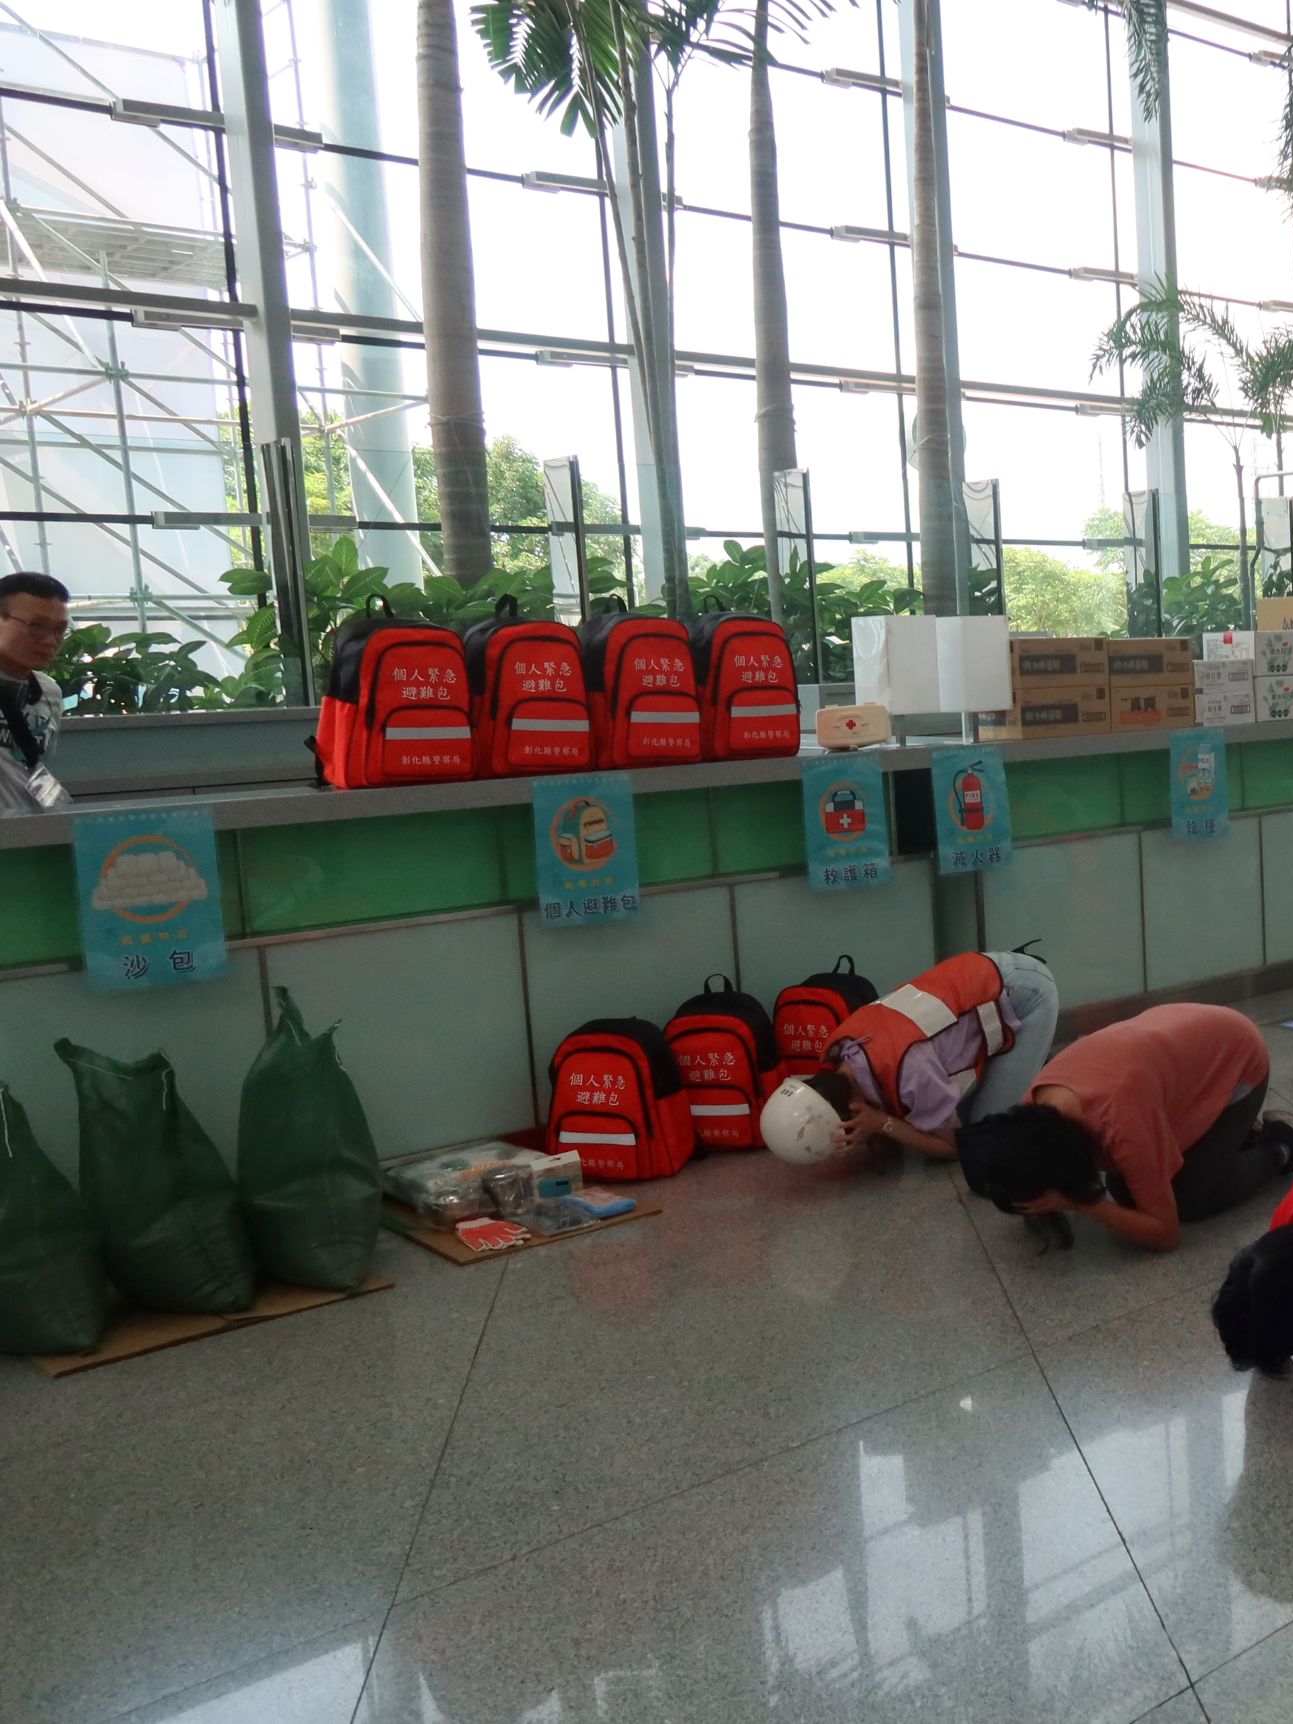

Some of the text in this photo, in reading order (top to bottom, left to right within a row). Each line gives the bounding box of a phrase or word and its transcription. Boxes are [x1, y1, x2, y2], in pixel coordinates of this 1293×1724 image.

[514, 661, 573, 676] 個人緊急
[634, 658, 685, 672] 個人緊急
[734, 655, 784, 668] 個人緊急
[392, 668, 457, 684] 個人緊急
[642, 675, 680, 687] 避難包
[741, 670, 777, 683] 避難包
[522, 678, 567, 692] 避難包
[401, 686, 451, 700] 避難包
[401, 754, 461, 766] 彰化縣警察局
[952, 847, 1001, 866] 滅火器
[823, 862, 878, 885] 救護箱
[544, 894, 638, 919] 個人避難包
[122, 950, 196, 979] 沙包
[783, 1023, 830, 1038] 個人緊急
[790, 1039, 824, 1051] 避難包
[679, 1052, 736, 1067] 個人緊急
[569, 1073, 626, 1090] 個人緊急
[688, 1068, 732, 1082] 避難包
[576, 1091, 620, 1106] 避難包
